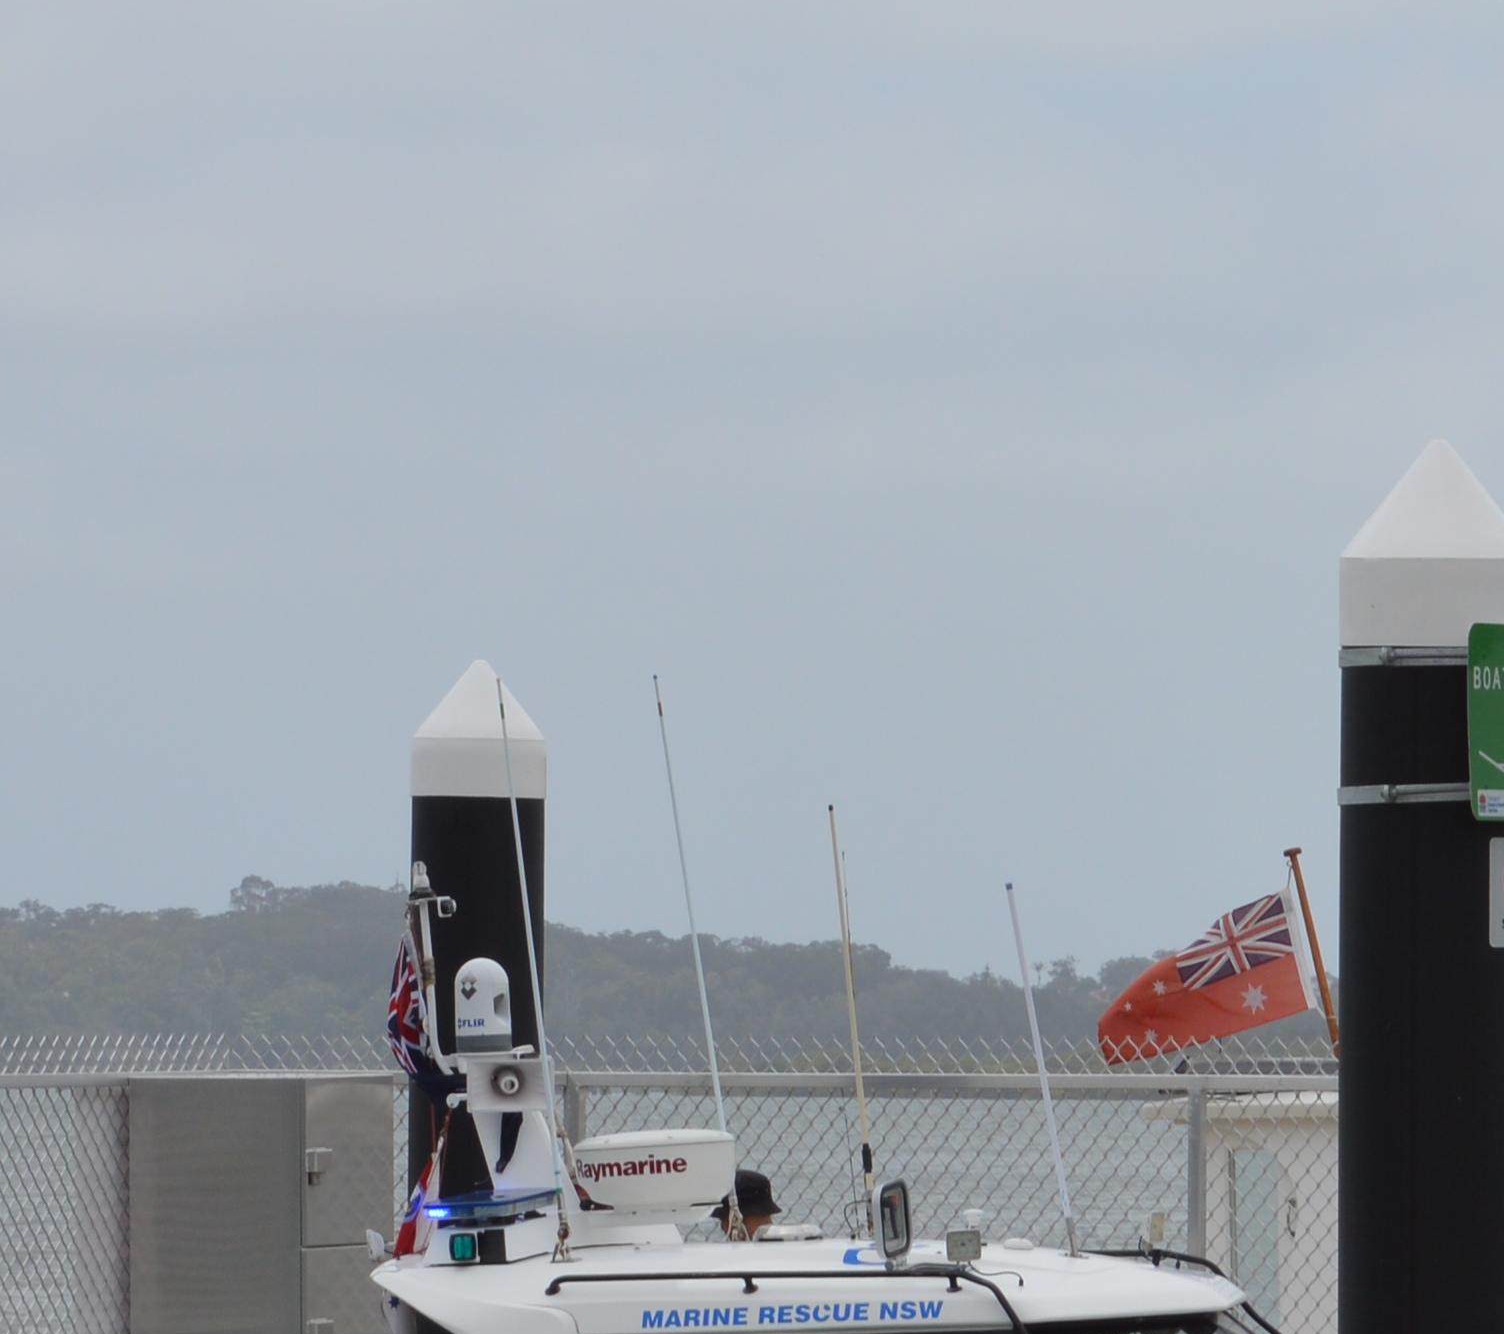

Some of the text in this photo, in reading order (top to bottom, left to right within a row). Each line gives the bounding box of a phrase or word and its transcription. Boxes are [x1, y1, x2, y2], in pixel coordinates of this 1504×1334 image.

[462, 1018, 485, 1028] FLIR
[575, 1153, 688, 1183] Raymarine
[641, 1300, 944, 1329] MARINE RESCUE NSW
